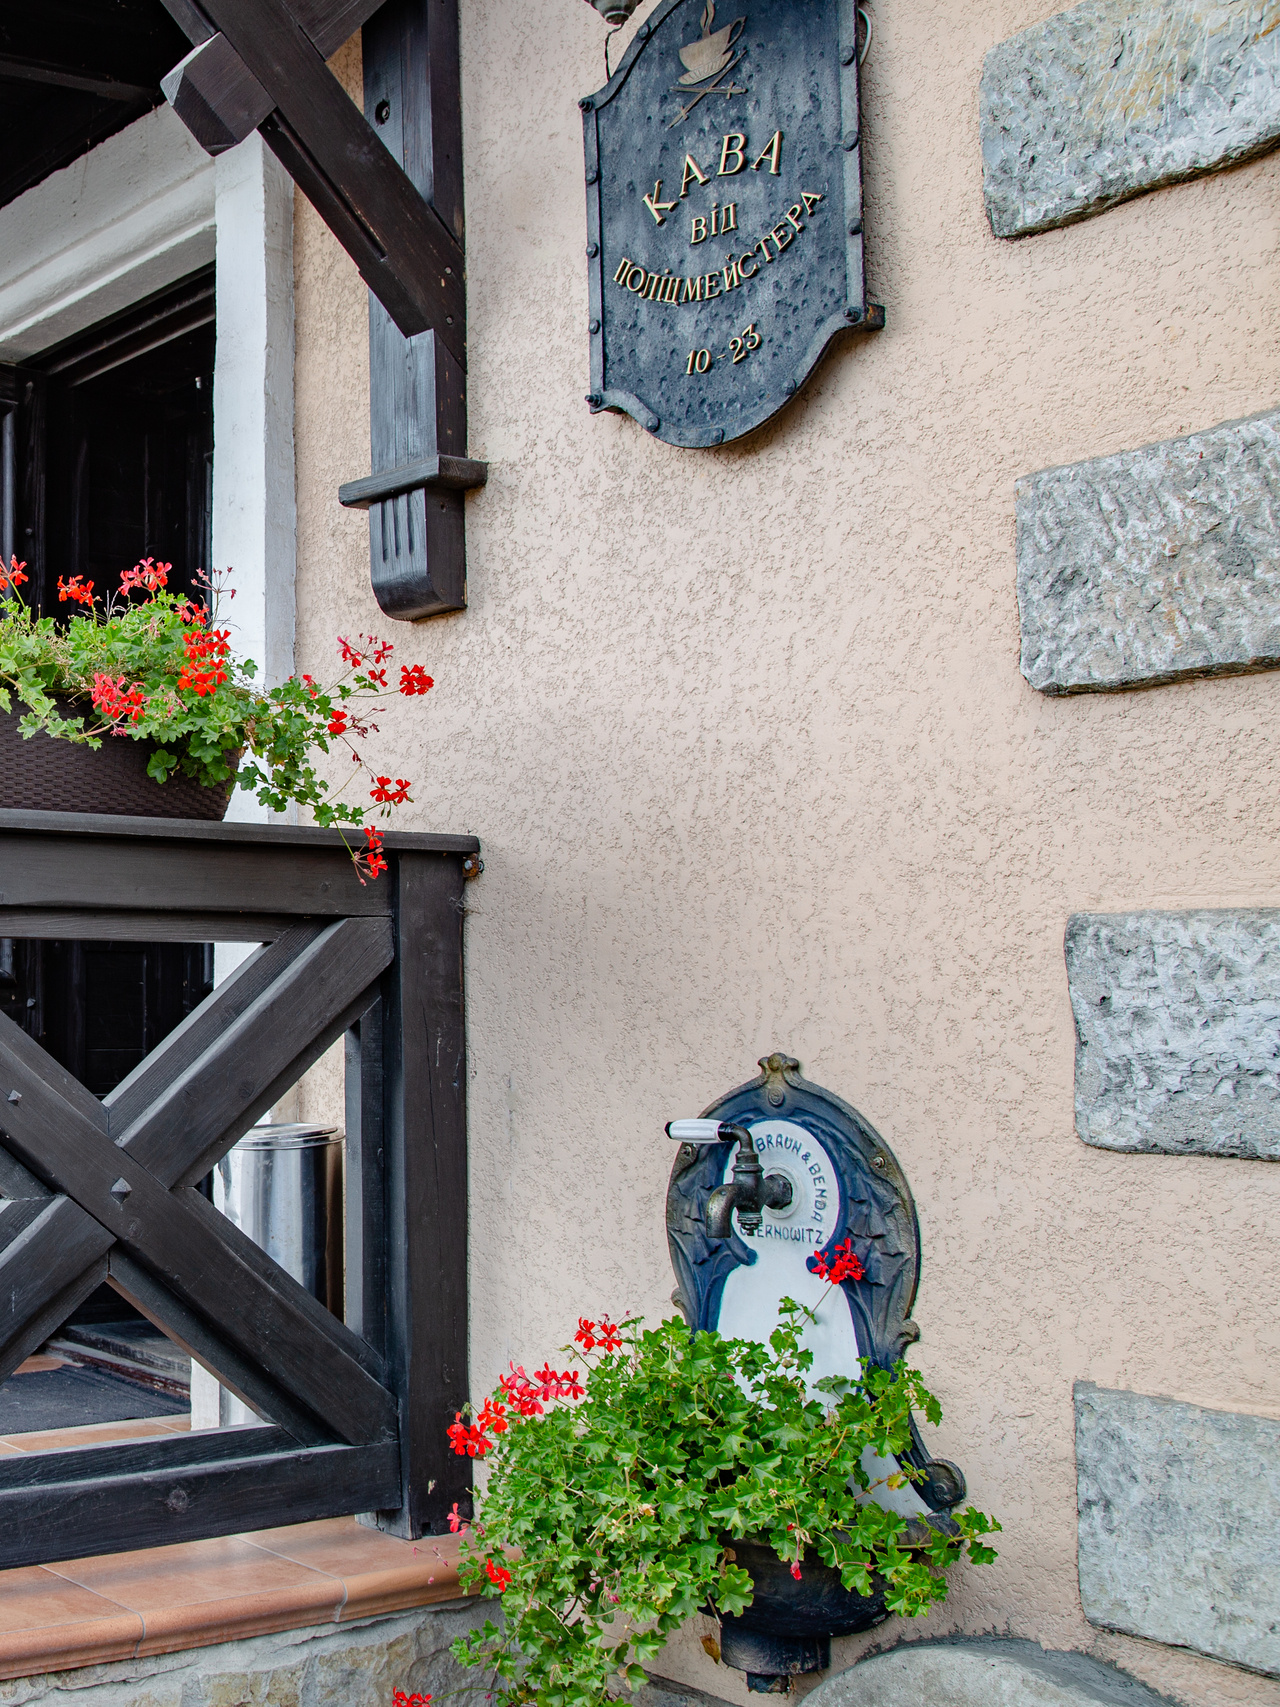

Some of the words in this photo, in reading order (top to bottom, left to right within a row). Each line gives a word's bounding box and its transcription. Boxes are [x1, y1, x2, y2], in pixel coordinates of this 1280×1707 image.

[642, 130, 785, 226] КАВА
[612, 190, 825, 306] ПОЛІЦМЕЙСТЕРА
[755, 1133, 802, 1155] BRAUN
[801, 1151, 811, 1164] &
[808, 1162, 828, 1223] BENDA
[740, 1224, 824, 1244] CERNOWITZ
